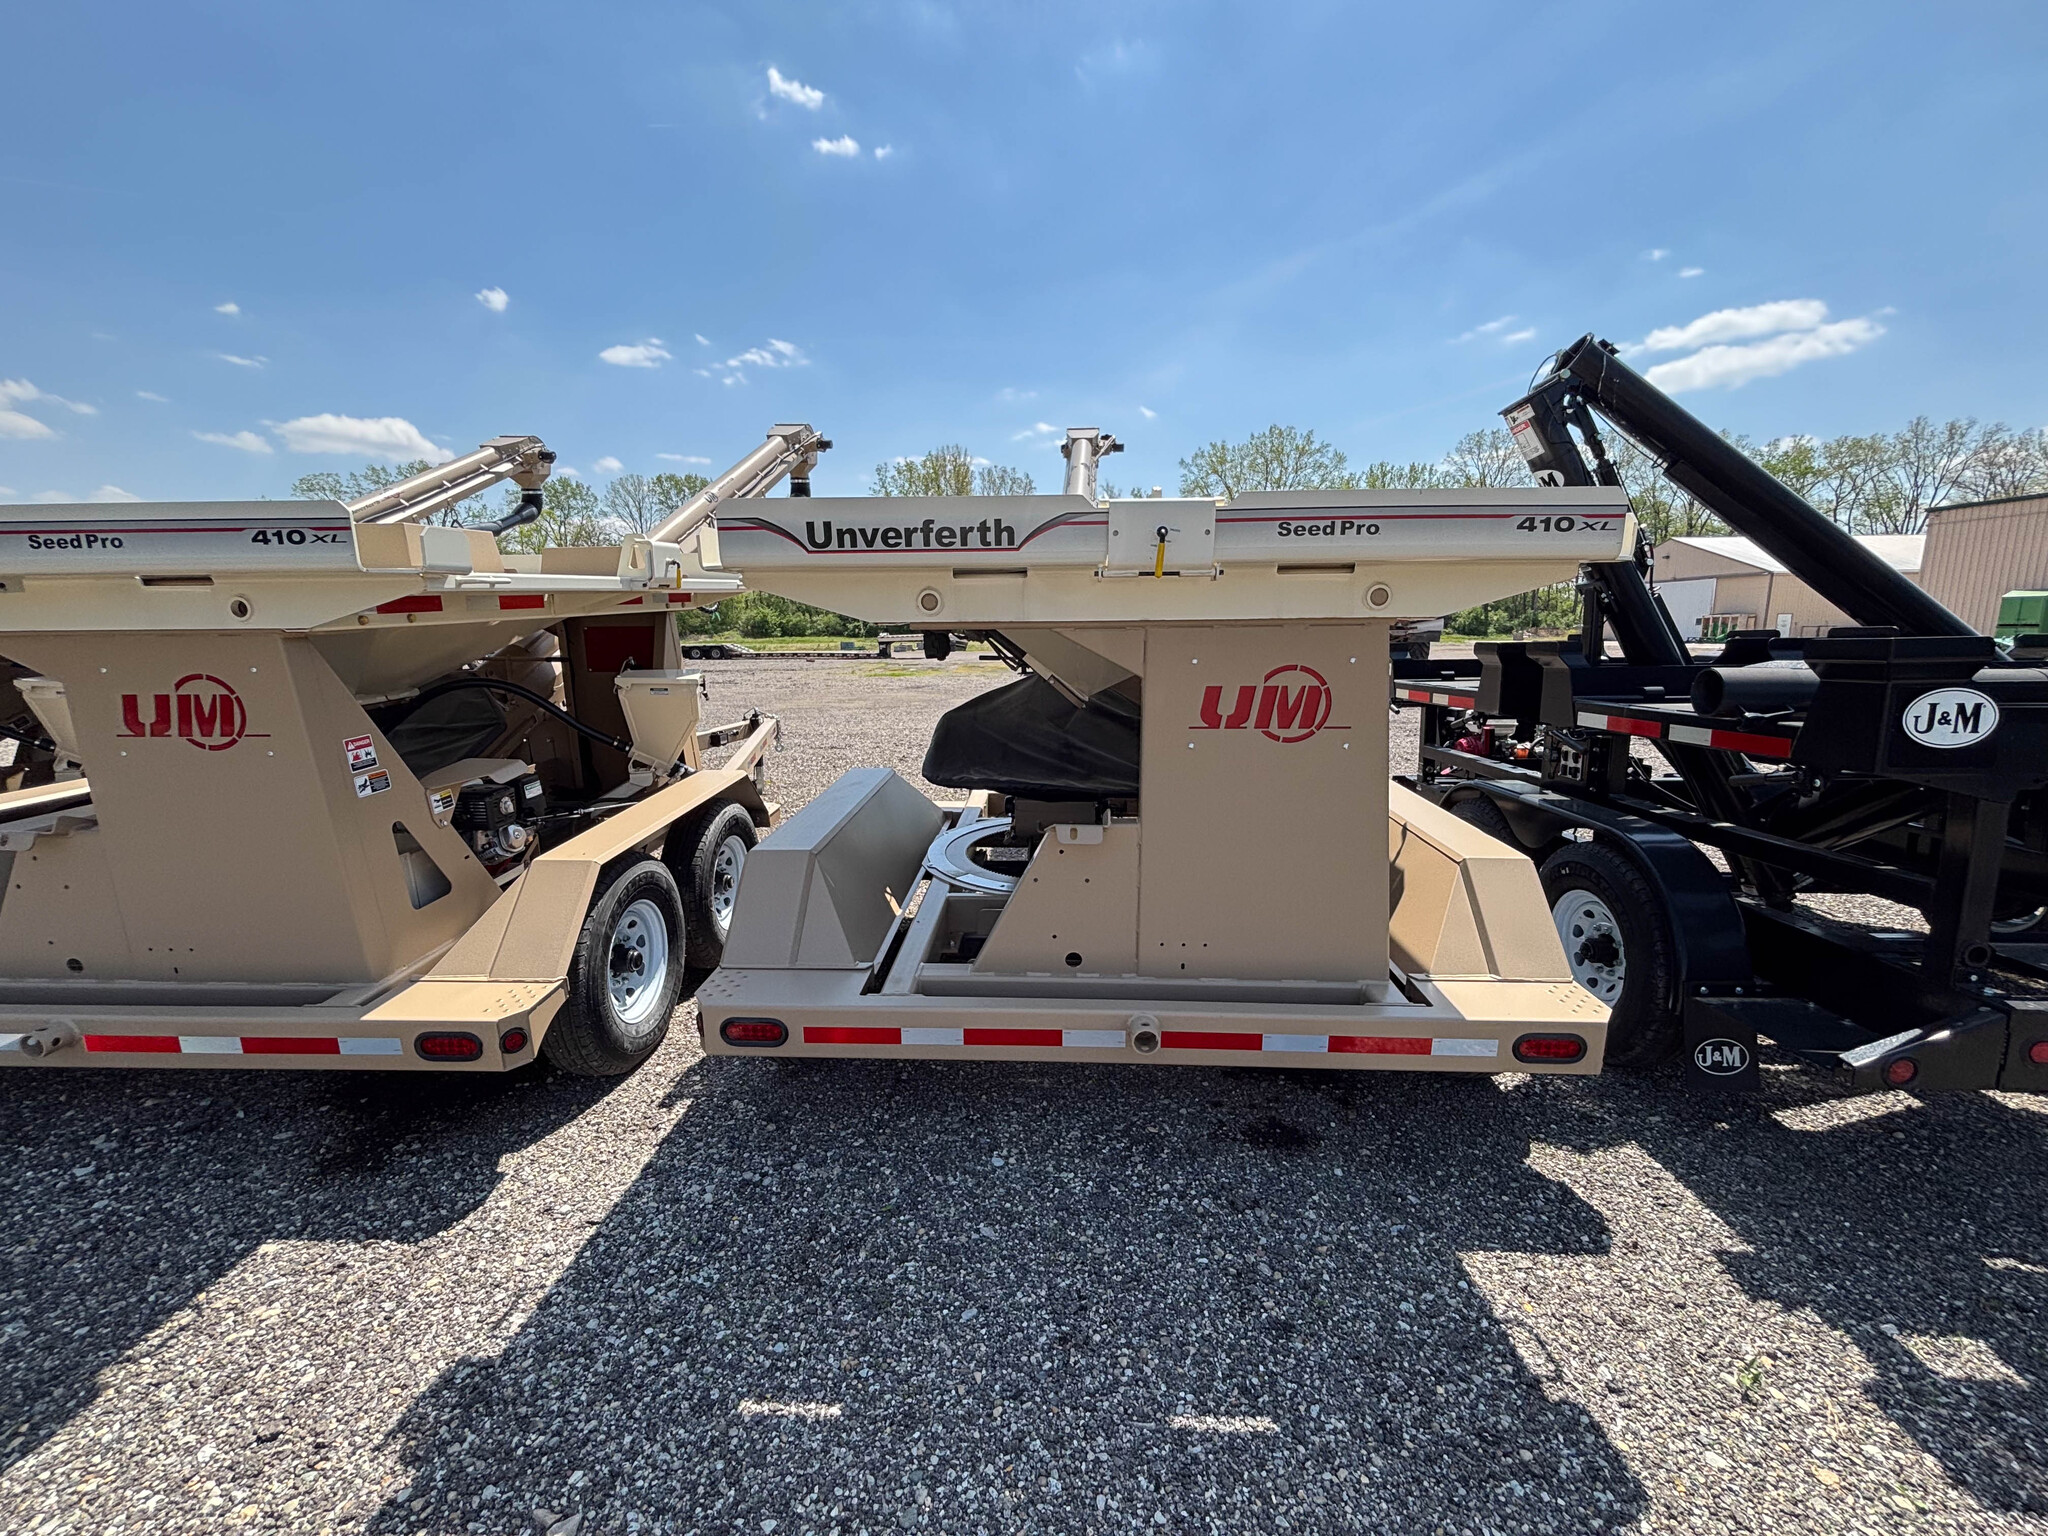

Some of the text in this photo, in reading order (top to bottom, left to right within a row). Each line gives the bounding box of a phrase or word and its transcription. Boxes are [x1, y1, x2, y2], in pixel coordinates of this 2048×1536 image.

[805, 518, 1016, 549] Unverferth
[1913, 702, 1985, 734] J&M
[1697, 1045, 1742, 1067] J&M
